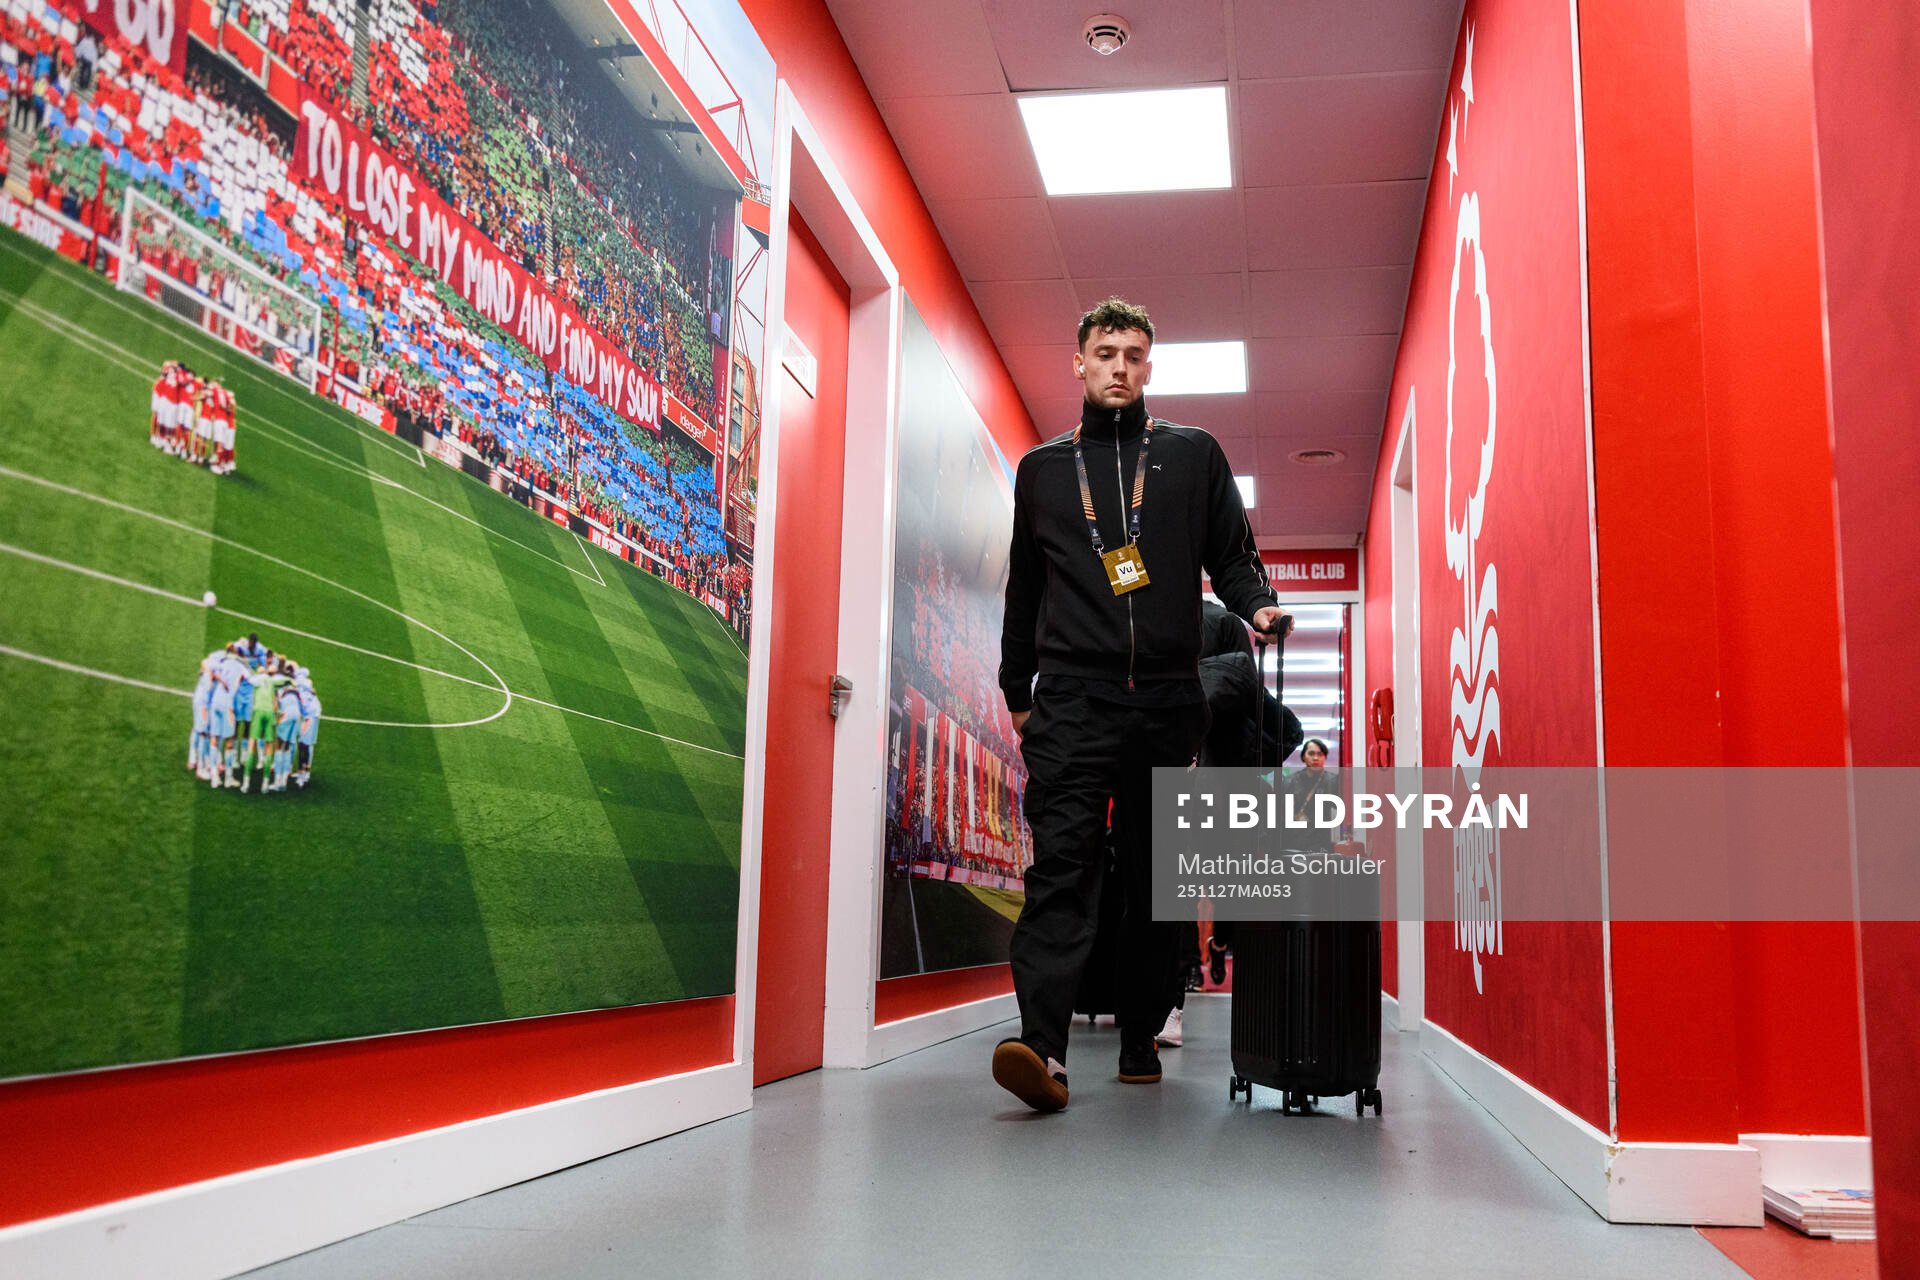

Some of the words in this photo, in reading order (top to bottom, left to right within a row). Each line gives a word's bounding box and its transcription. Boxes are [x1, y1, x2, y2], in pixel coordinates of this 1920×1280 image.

[301, 100, 343, 195] TO
[347, 140, 416, 249] LOSE
[419, 201, 460, 284] MY
[517, 282, 557, 358] AND
[599, 350, 625, 411] MY
[626, 367, 662, 431] SOUL
[1119, 566, 1133, 575] Vu
[1311, 563, 1345, 579] CLUB
